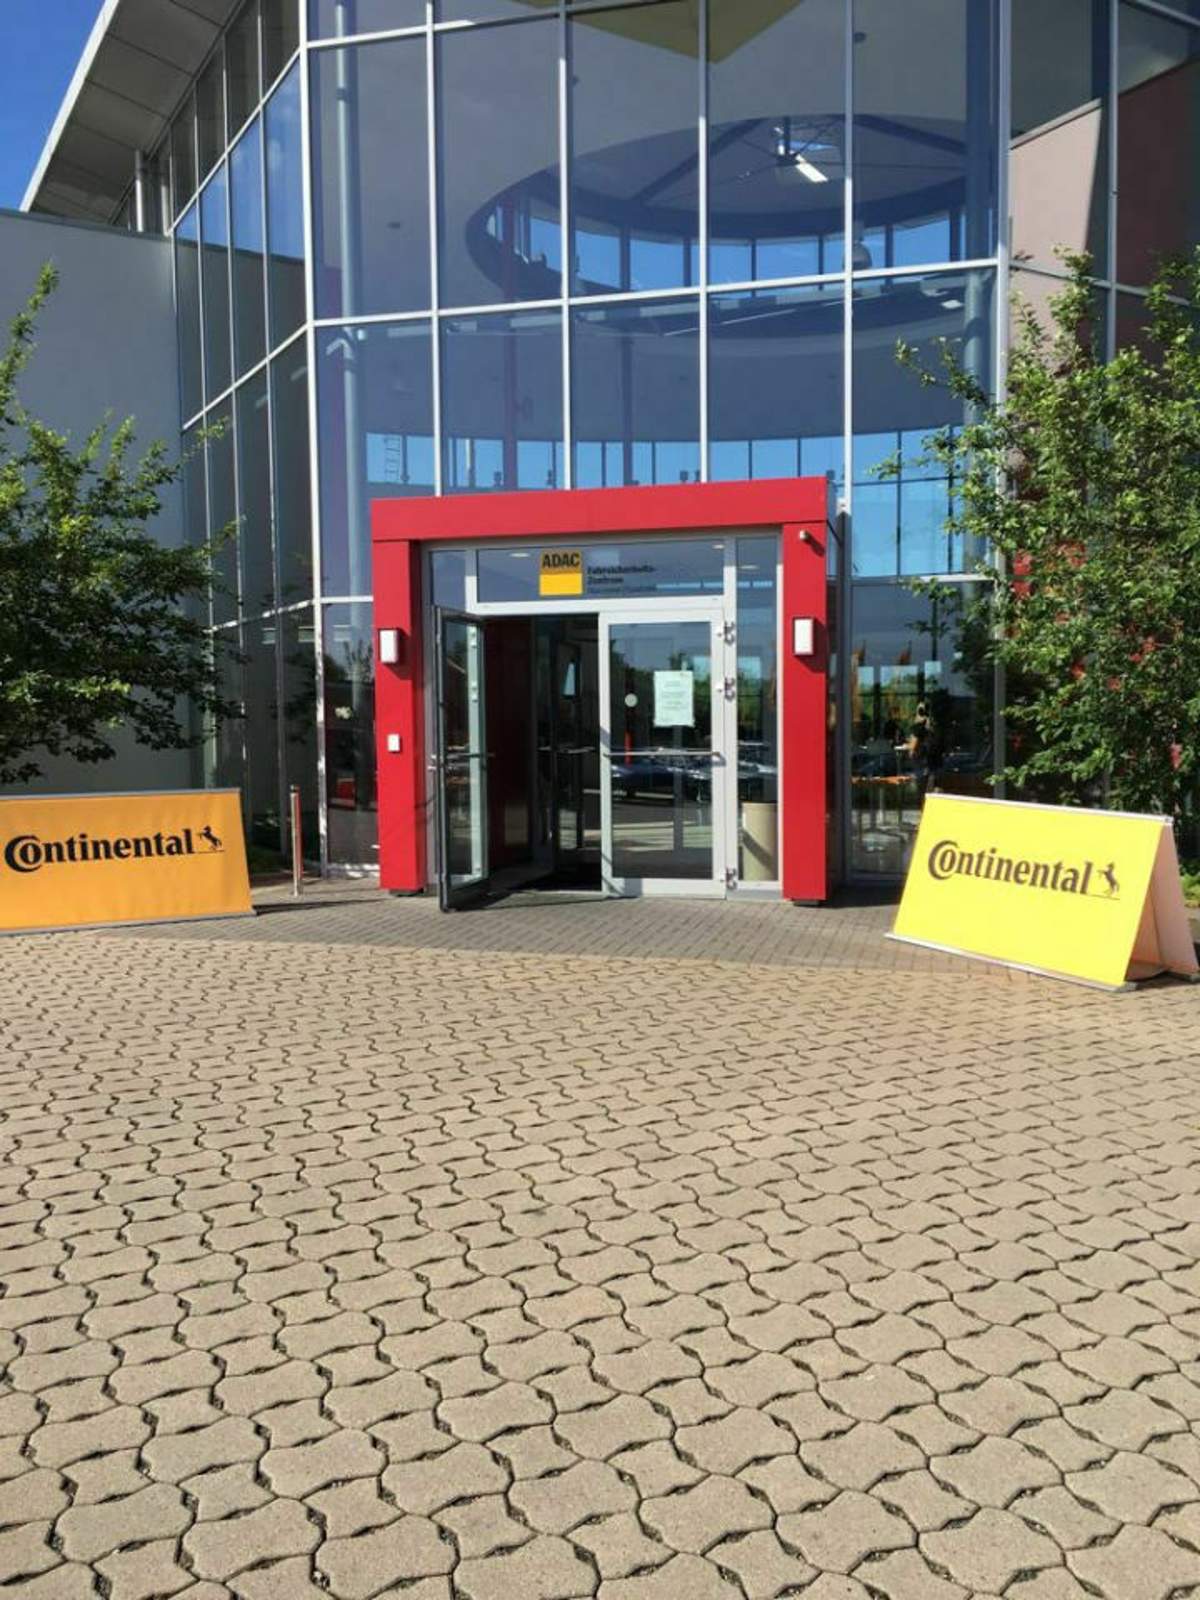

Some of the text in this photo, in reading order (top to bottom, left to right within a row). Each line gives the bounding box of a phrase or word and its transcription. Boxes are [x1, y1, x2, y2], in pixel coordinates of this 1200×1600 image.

[542, 552, 580, 568] ADAC
[4, 828, 194, 873] Continental
[928, 840, 1093, 895] Continental
